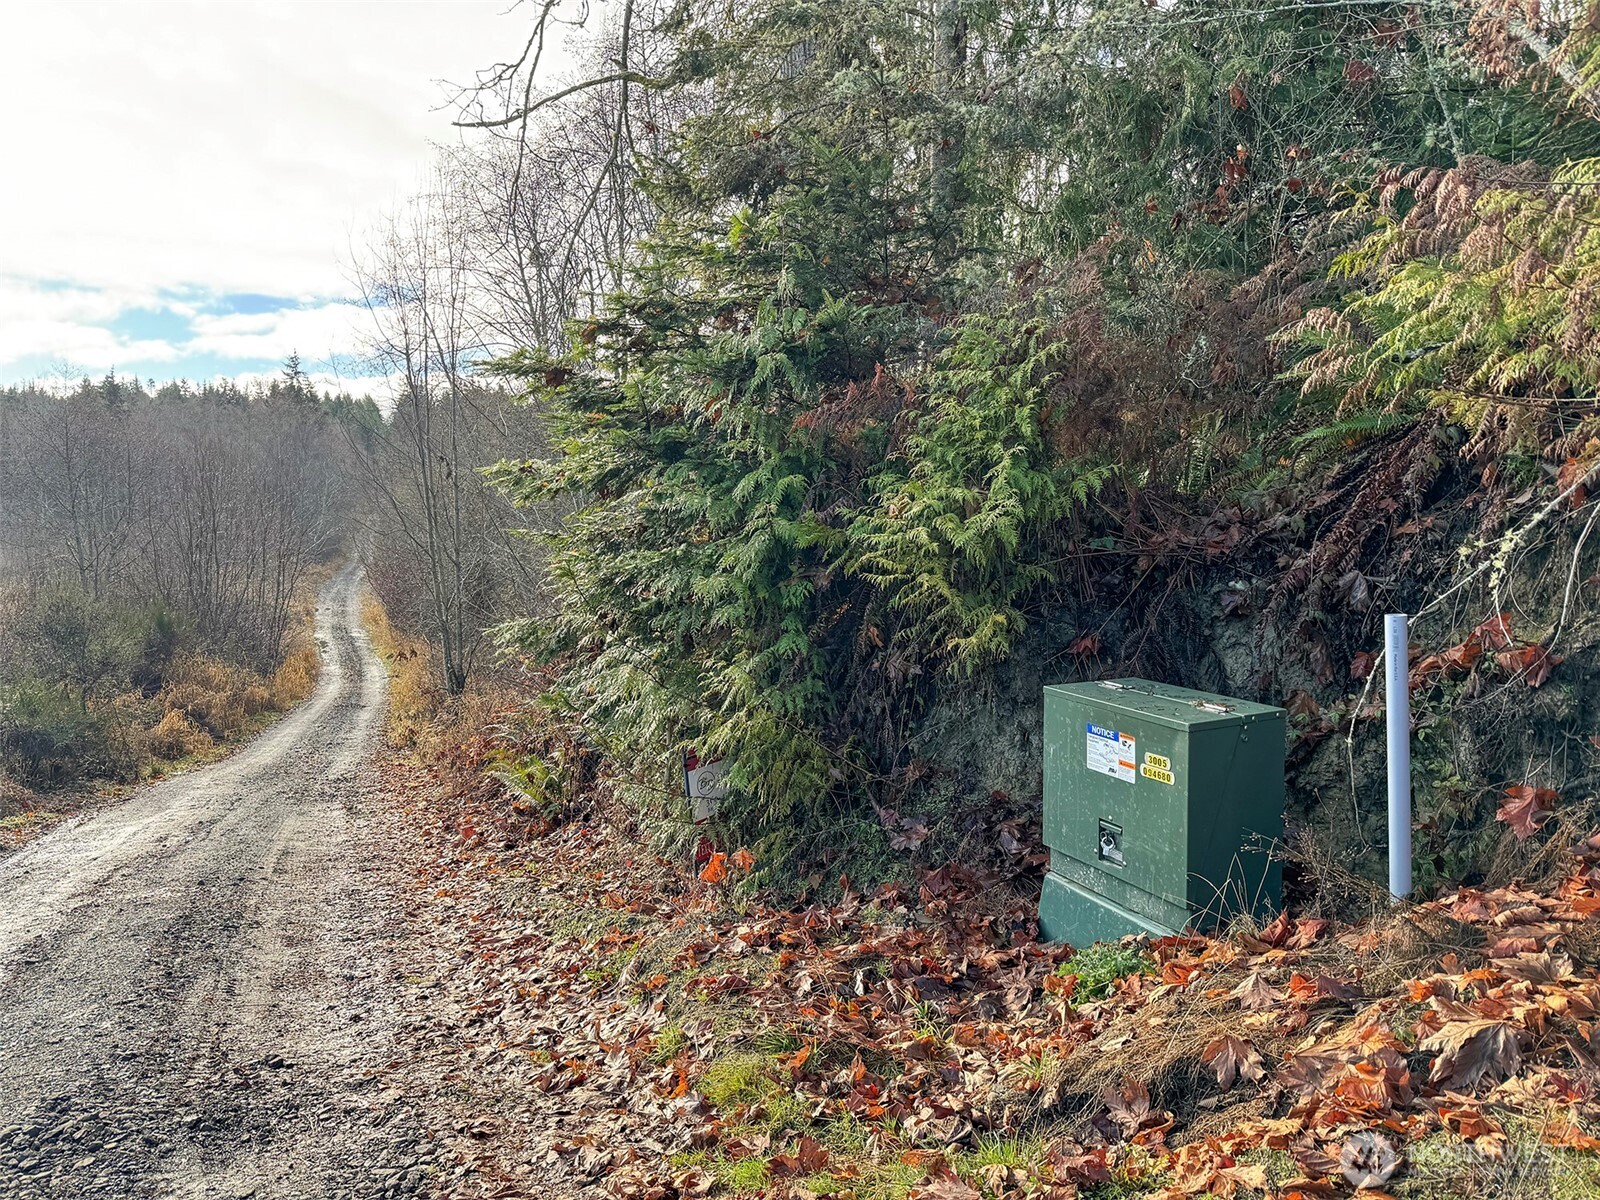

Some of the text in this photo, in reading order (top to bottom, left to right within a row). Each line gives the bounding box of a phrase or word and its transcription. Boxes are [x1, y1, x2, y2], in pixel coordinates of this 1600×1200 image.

[1091, 725, 1115, 739] NOTICE
[1148, 755, 1167, 768] 3005
[1143, 766, 1171, 782] 094680
